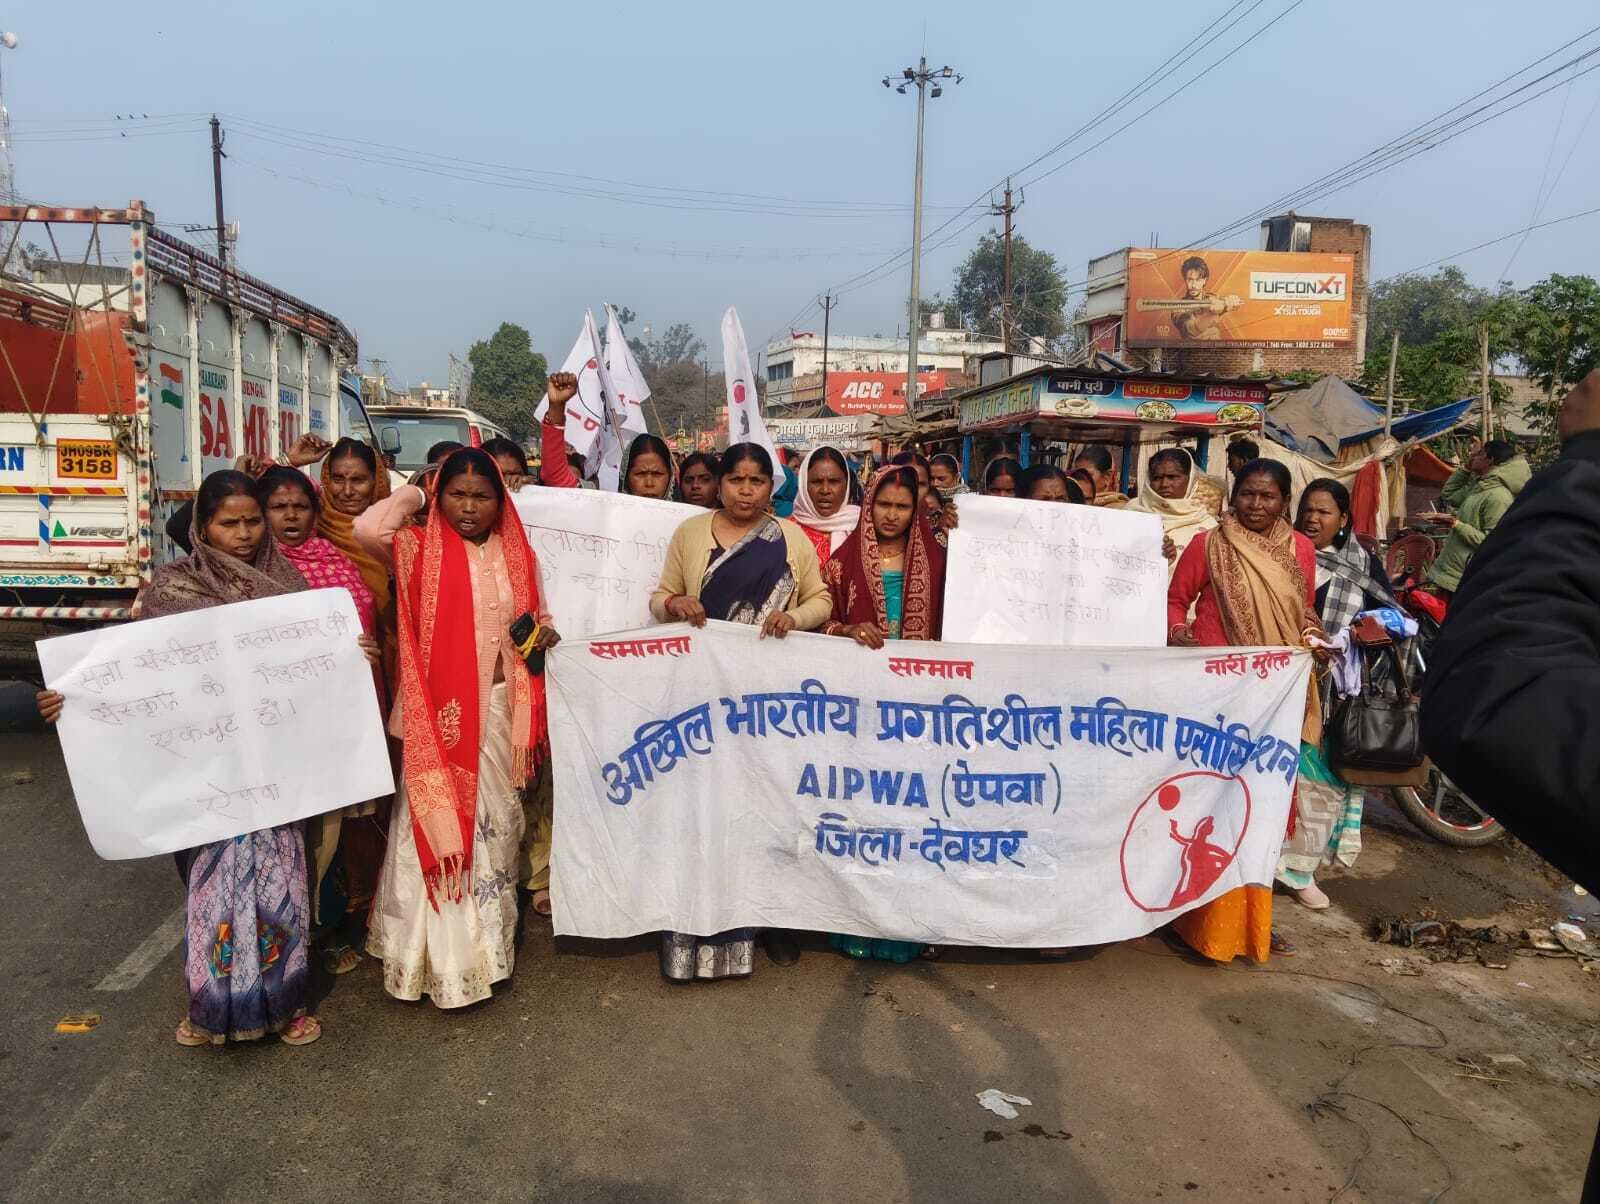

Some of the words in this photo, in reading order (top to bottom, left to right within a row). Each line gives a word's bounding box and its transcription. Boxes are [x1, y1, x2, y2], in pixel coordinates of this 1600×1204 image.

[841, 381, 884, 399] ACC
[1057, 380, 1081, 392] पानी
[61, 445, 112, 457] JH09BK
[62, 458, 112, 474] 3158
[590, 635, 691, 659] समानता
[888, 656, 975, 679] सम्मान
[1205, 654, 1248, 676] नारी
[601, 702, 714, 805] अखिल
[719, 678, 859, 738] भारतीय
[877, 694, 1061, 750] प्रगतिशील
[1070, 696, 1168, 756] महिला
[797, 763, 929, 808] AIPWA
[942, 760, 1061, 818] (ऐपवा)
